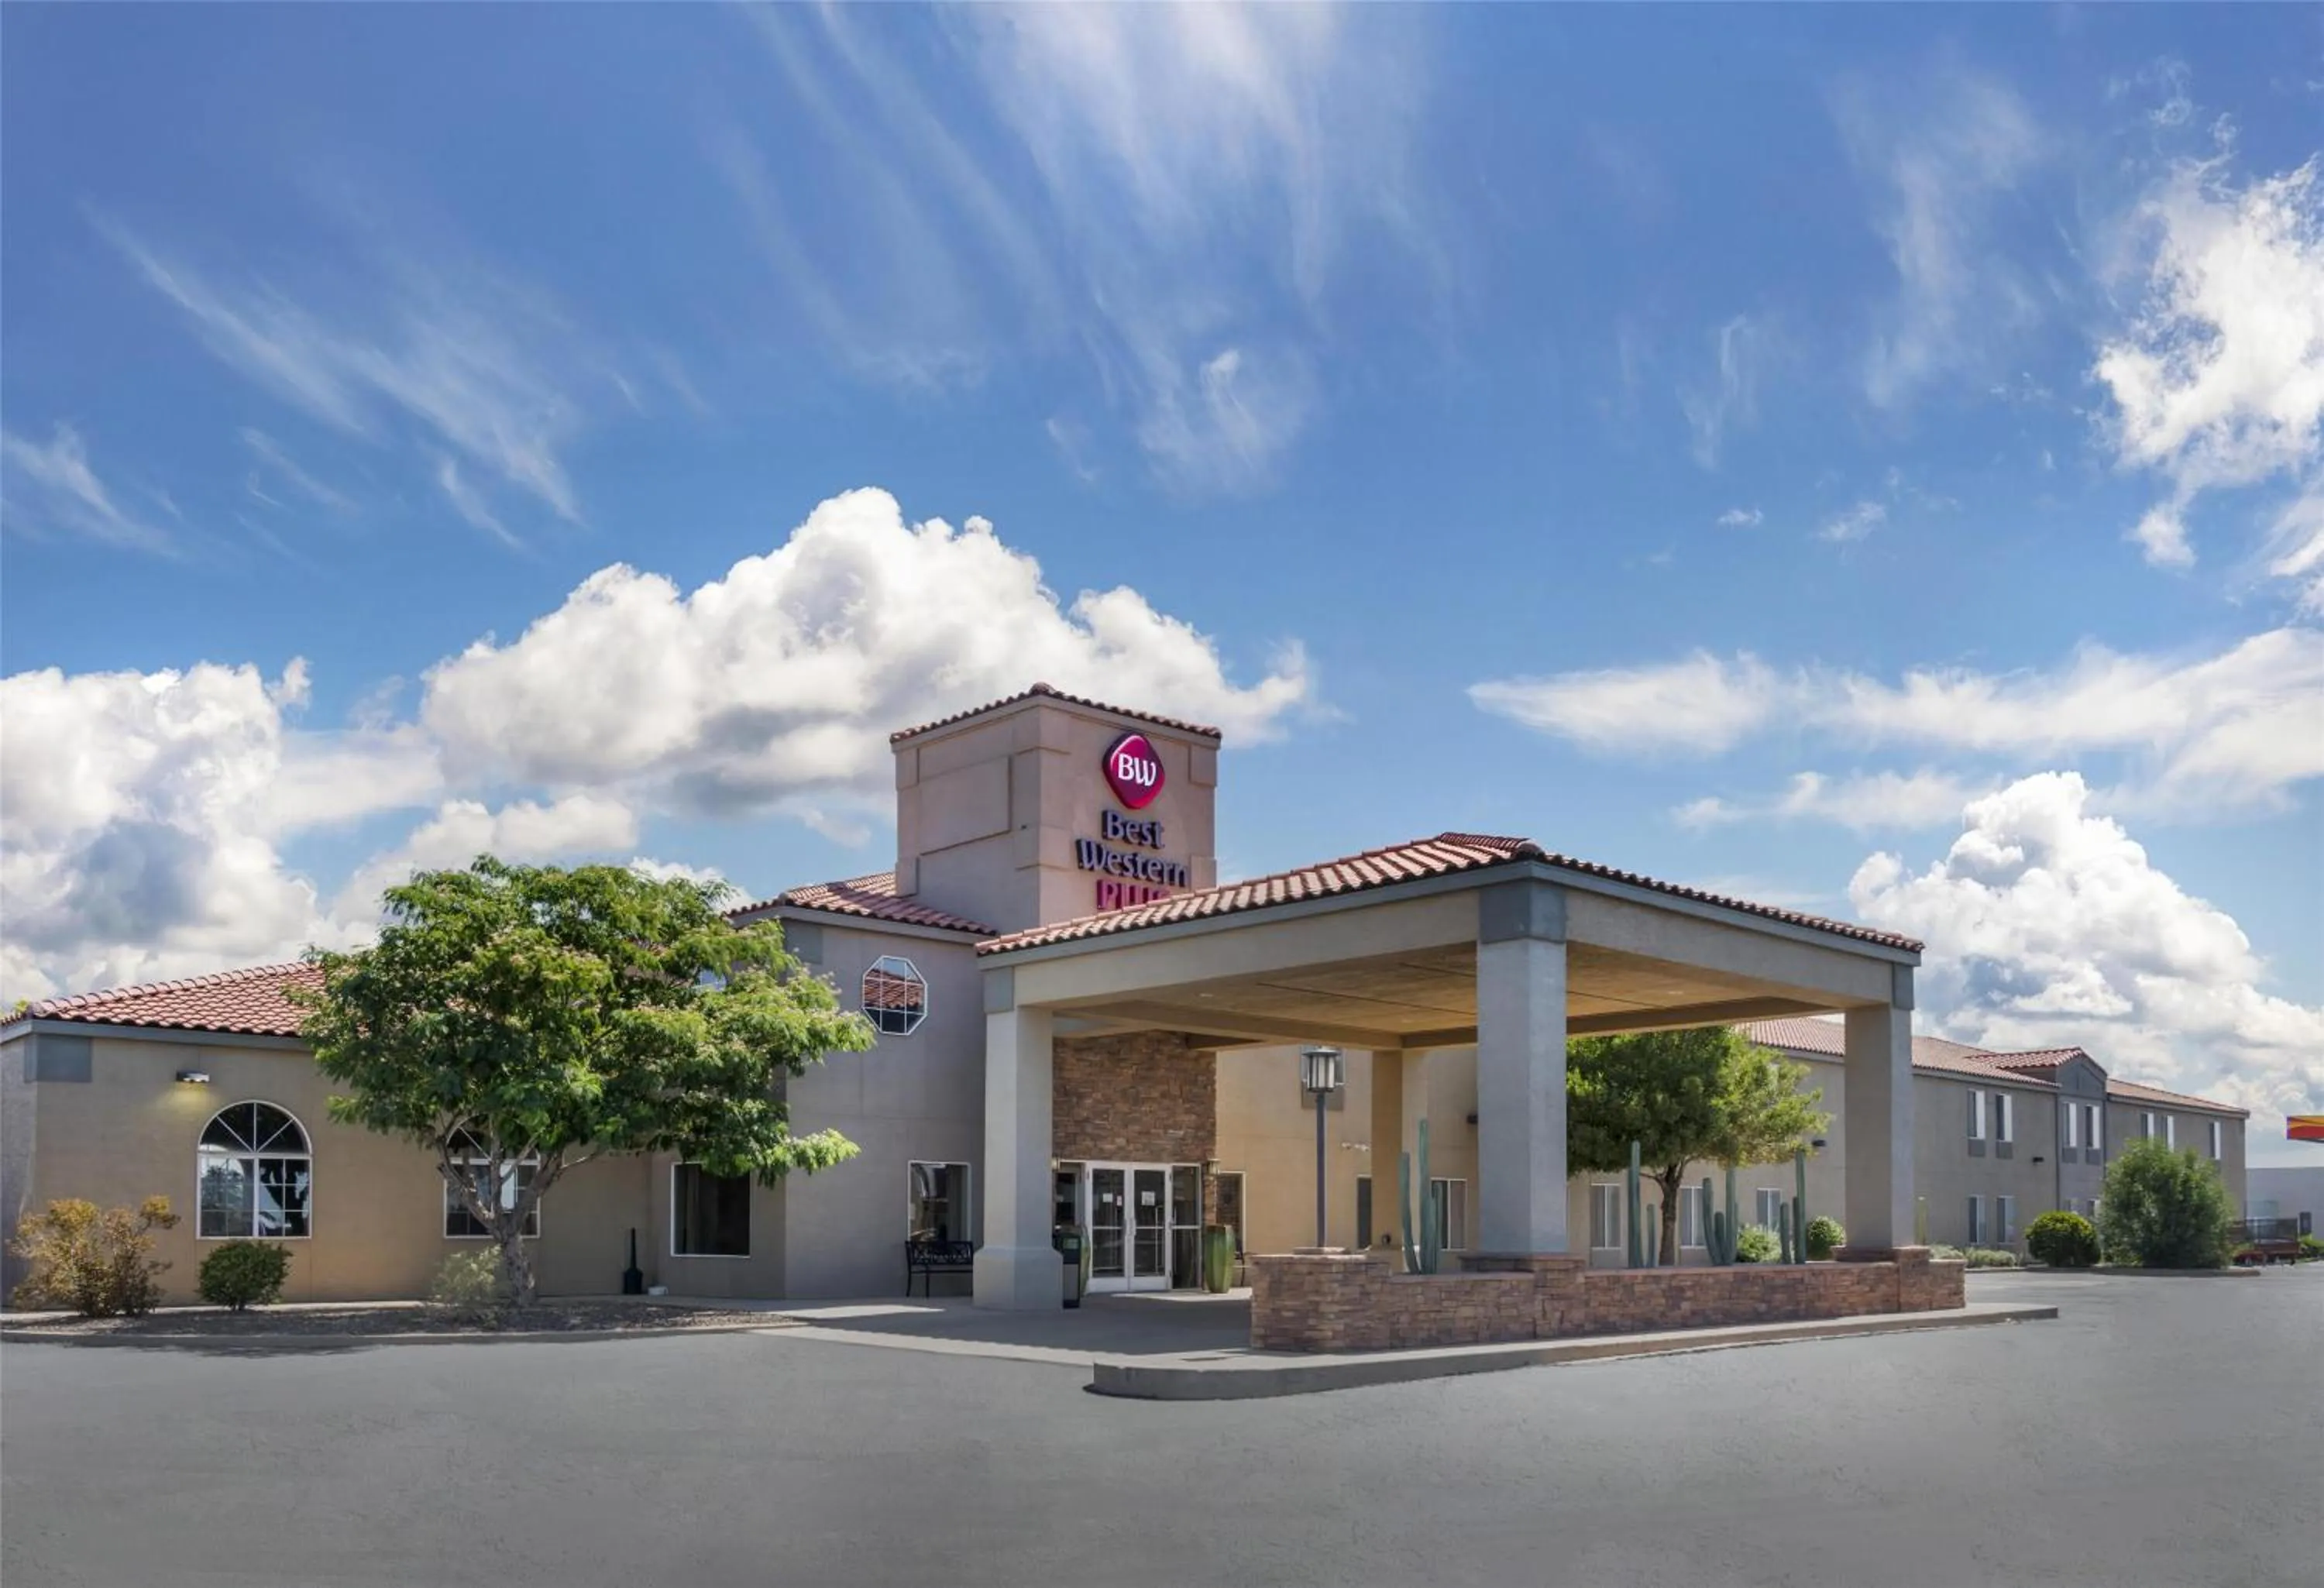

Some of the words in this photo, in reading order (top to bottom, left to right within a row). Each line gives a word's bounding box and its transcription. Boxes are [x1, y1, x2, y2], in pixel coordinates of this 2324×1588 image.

[1118, 754, 1157, 785] BW
[1102, 810, 1165, 848] Best
[1077, 839, 1188, 887] Western
